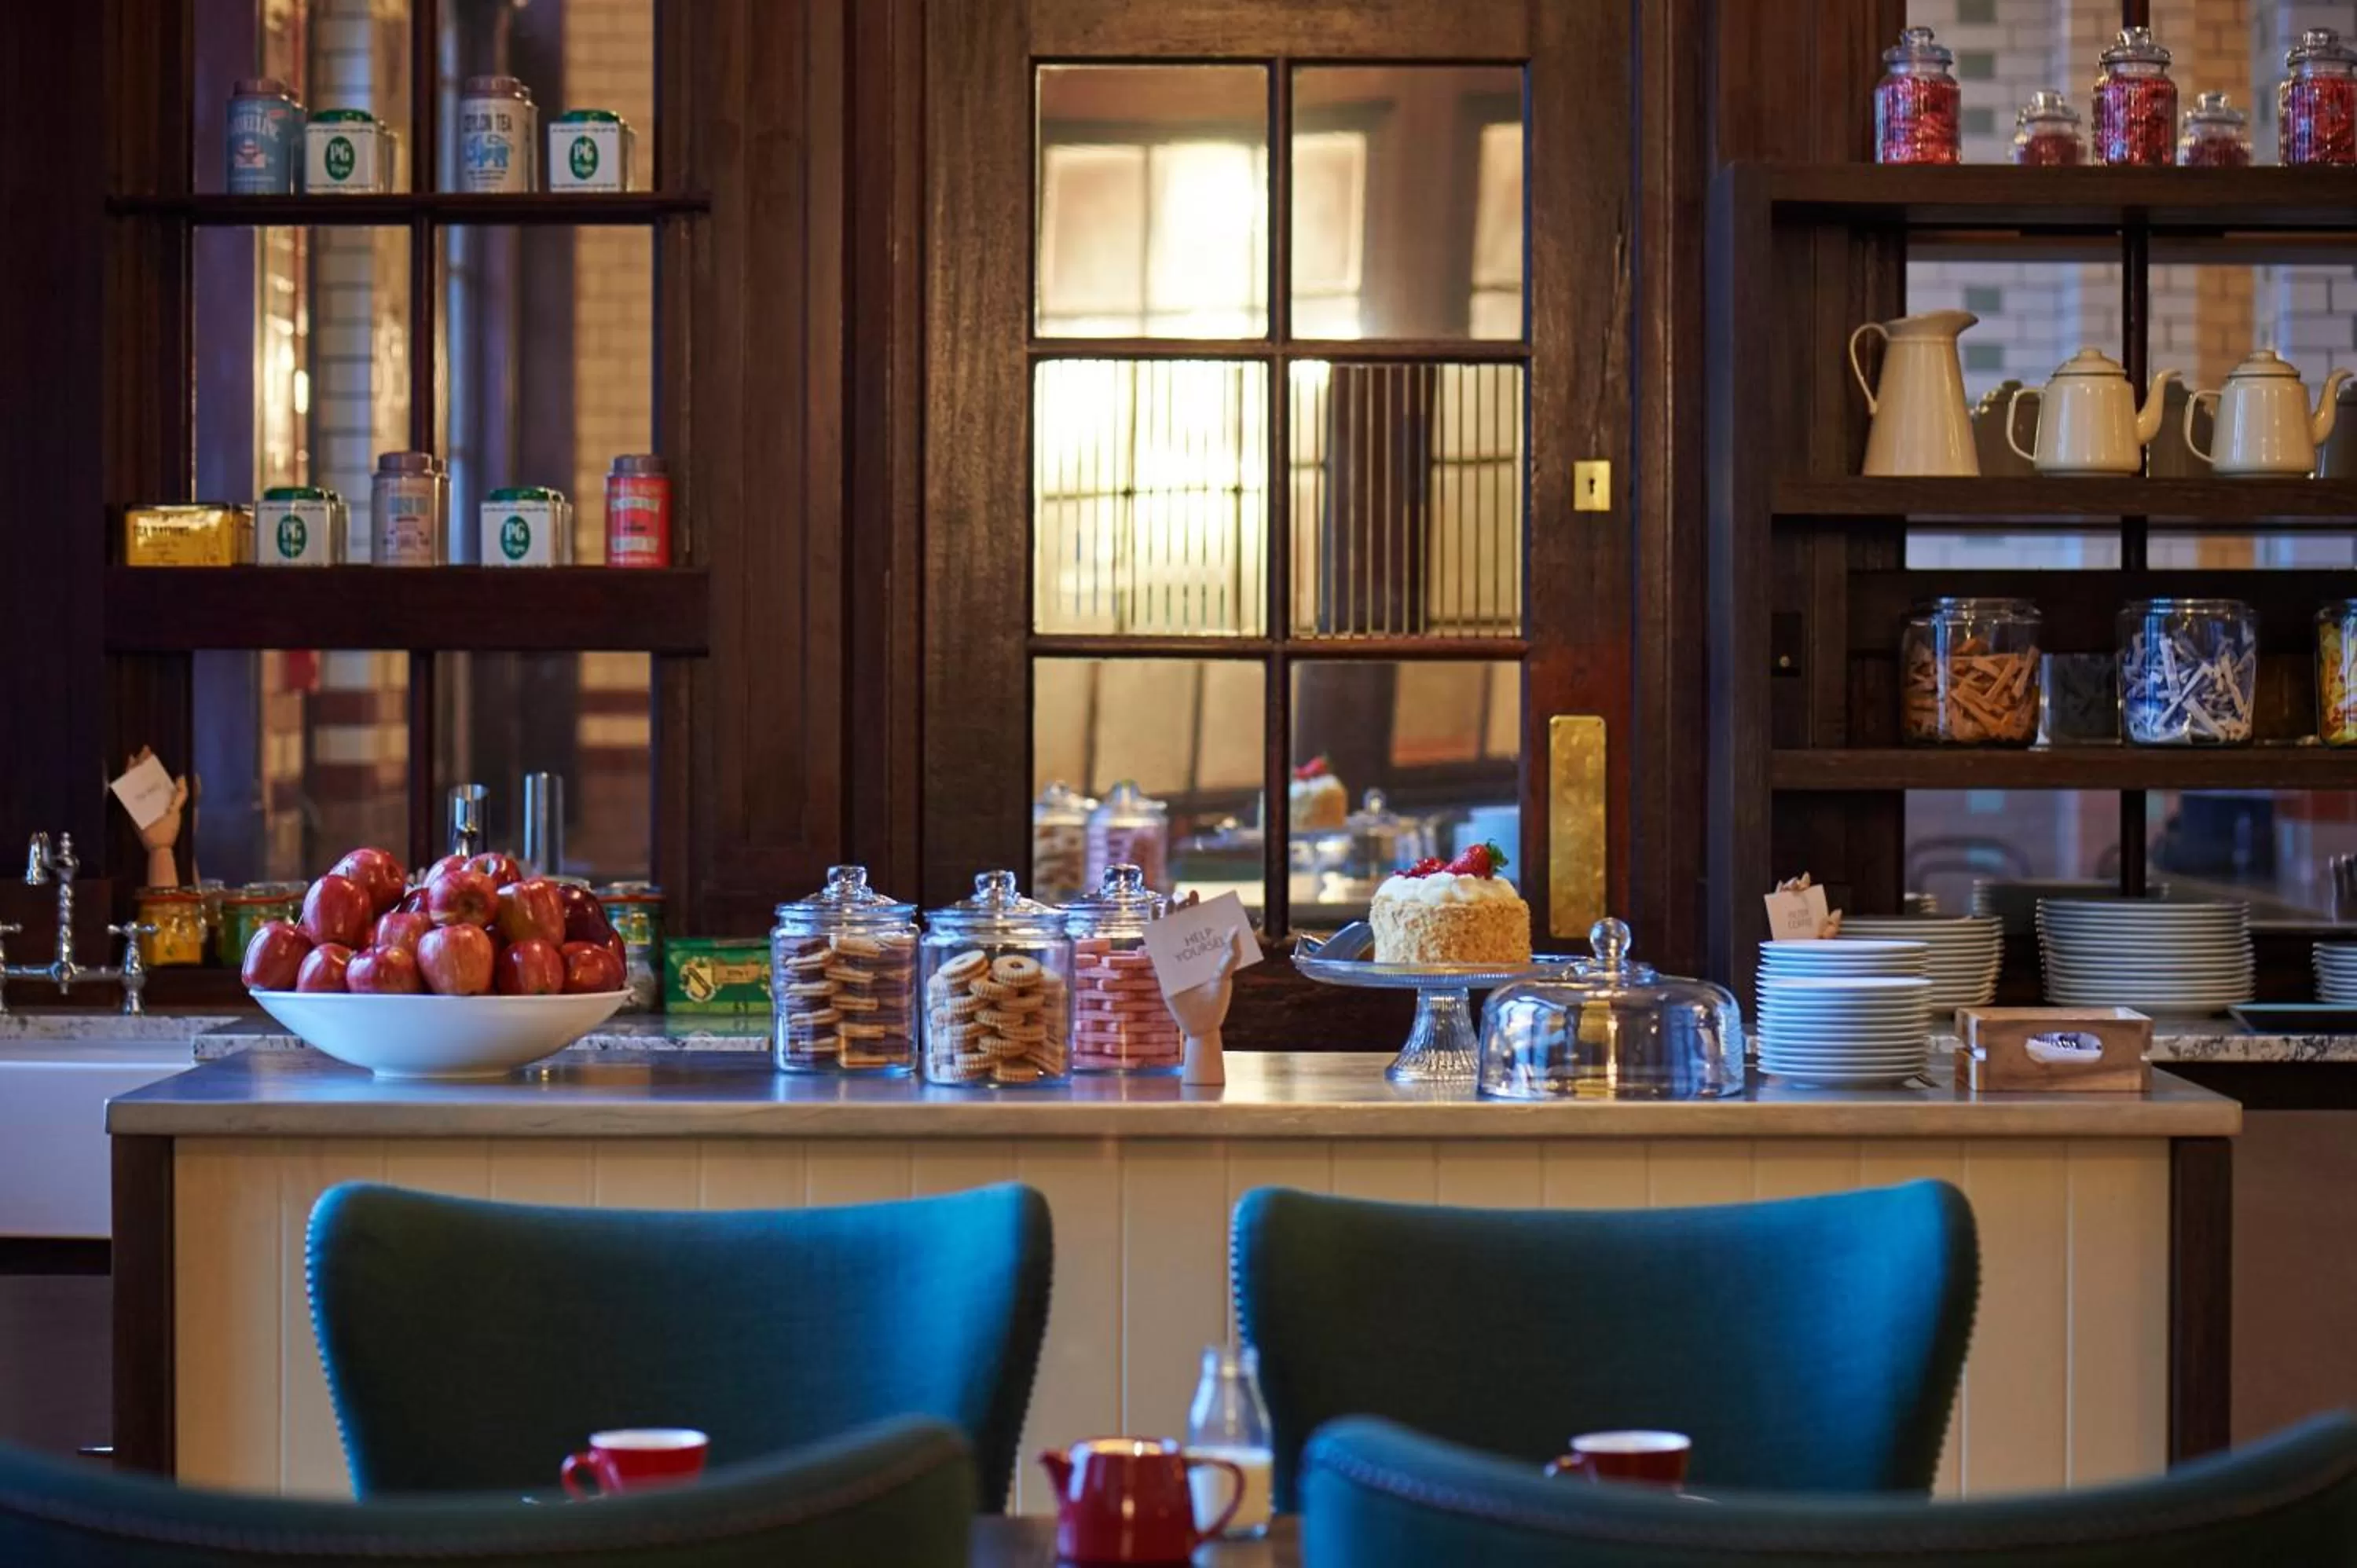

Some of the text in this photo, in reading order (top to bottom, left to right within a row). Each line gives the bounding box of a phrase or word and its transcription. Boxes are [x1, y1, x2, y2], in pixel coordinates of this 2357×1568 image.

[330, 143, 350, 162] PG
[574, 143, 594, 162] PG
[282, 521, 302, 540] PG
[505, 522, 526, 541] PG
[1184, 927, 1215, 947] HELP
[1174, 936, 1225, 962] YOURSEL
